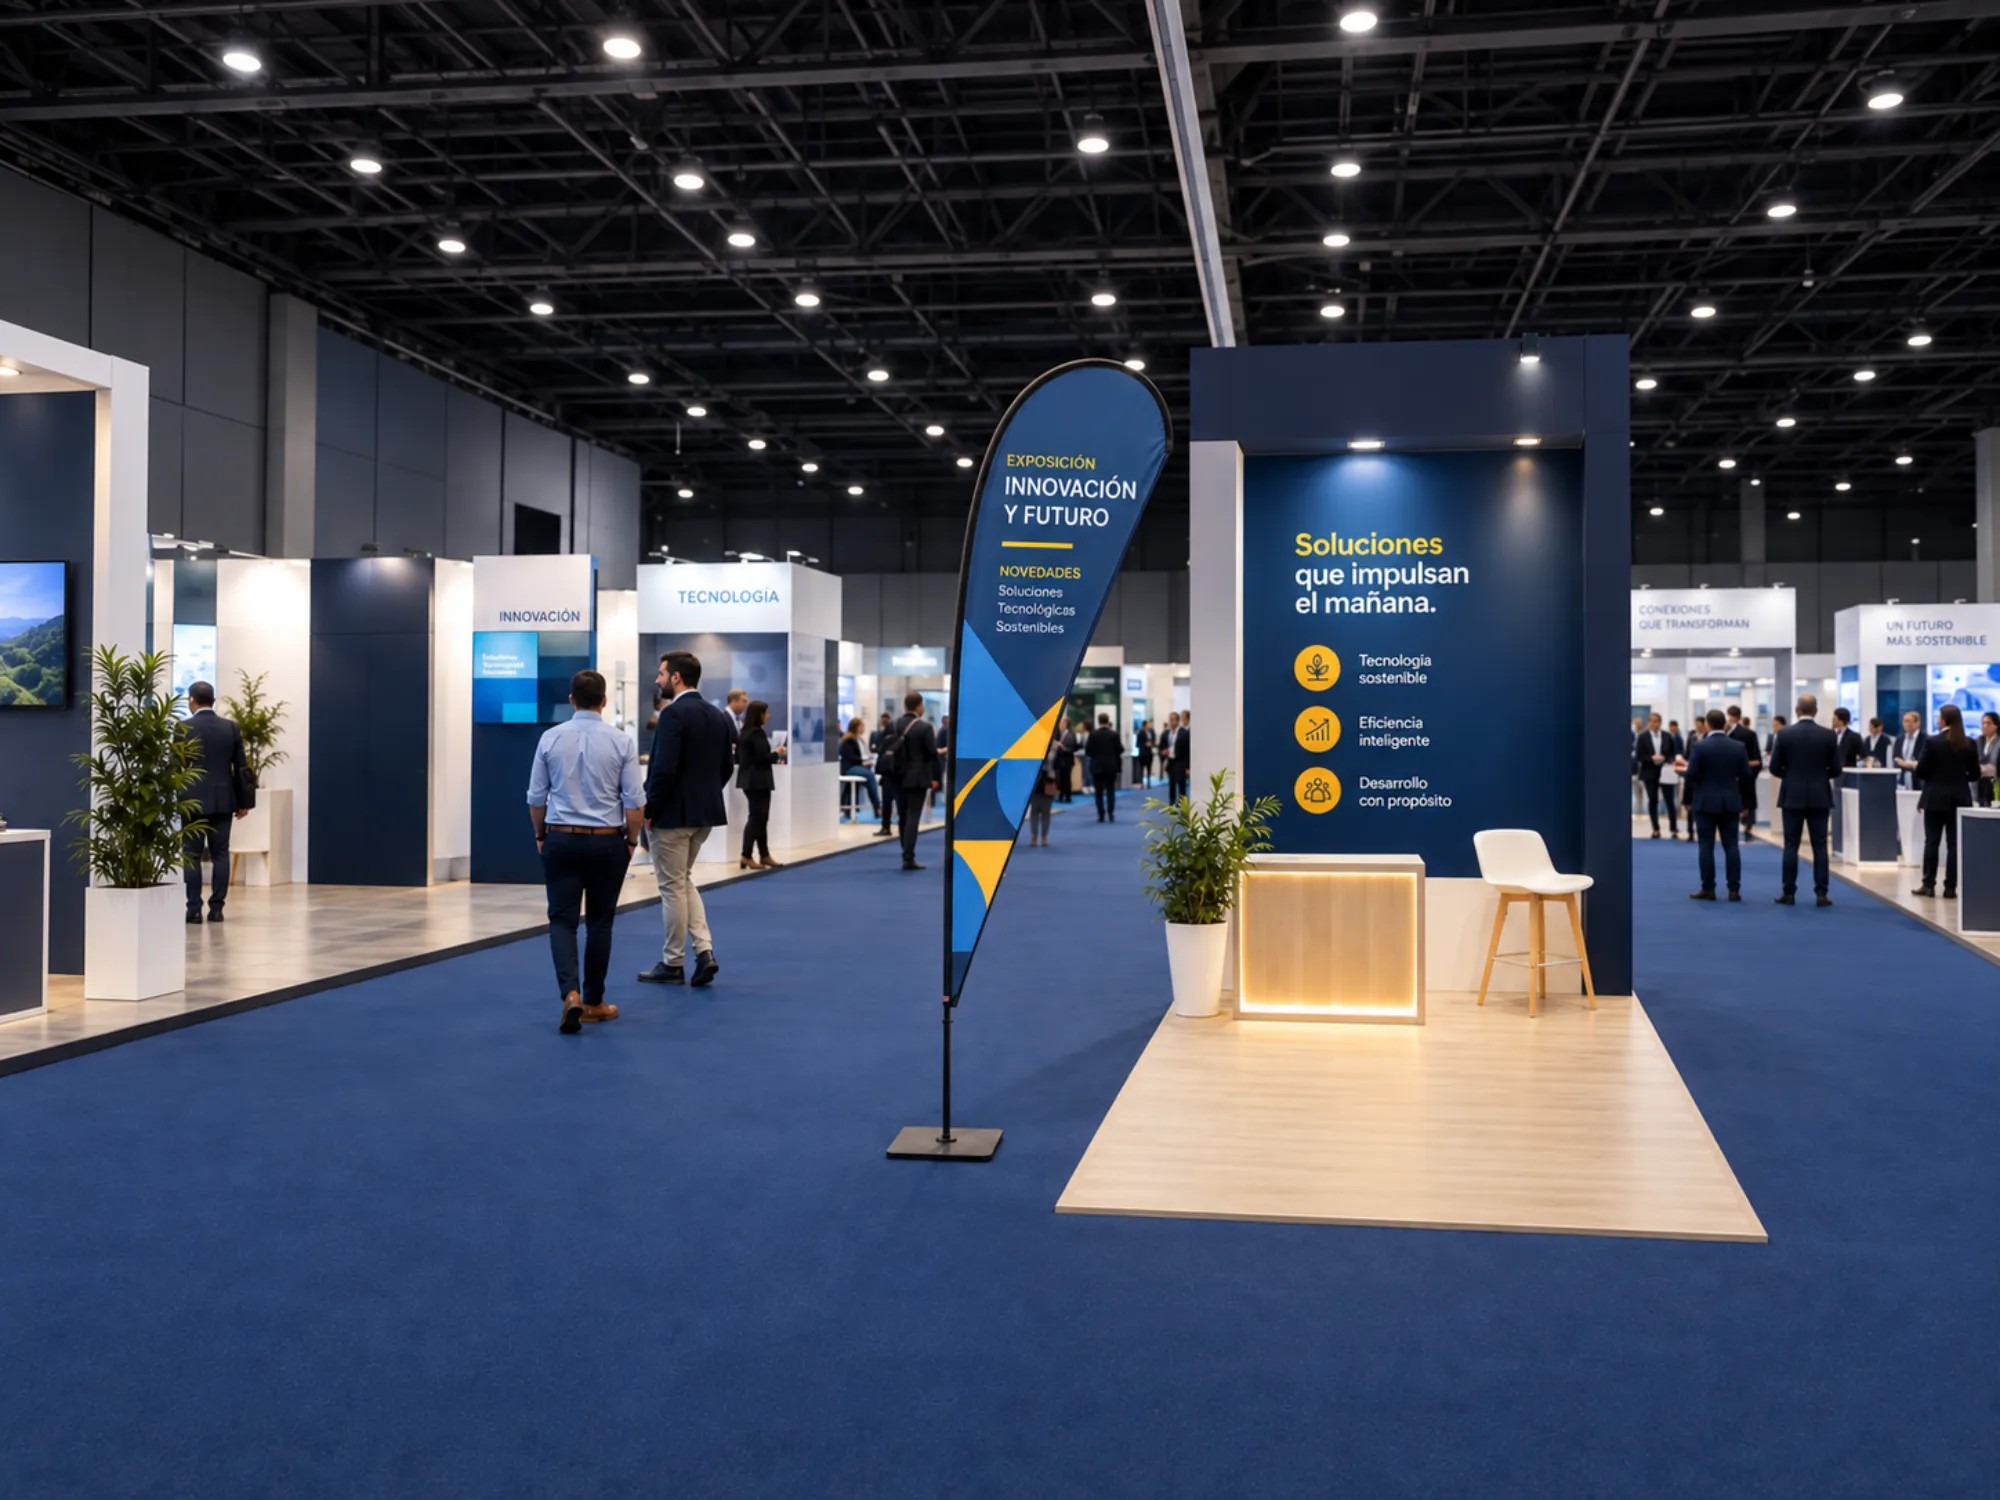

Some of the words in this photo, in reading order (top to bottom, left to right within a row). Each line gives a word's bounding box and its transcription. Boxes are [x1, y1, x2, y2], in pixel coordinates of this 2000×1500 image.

[1006, 453, 1096, 470] EXPOSICIÓN
[1004, 474, 1137, 500] INNOVACIÓN
[1003, 503, 1018, 524] Y
[1023, 505, 1110, 527] FUTURO
[1295, 531, 1444, 556] Soluciones
[999, 565, 1081, 580] NOVEDADES
[1295, 567, 1345, 591] que
[1351, 561, 1470, 591] impulsan
[998, 584, 1064, 598] Soluciones
[1295, 591, 1317, 614] el
[1324, 590, 1437, 614] mañana.
[499, 608, 581, 623] INNOVACIÓN
[995, 620, 1065, 634] Sostenibles
[1638, 620, 1662, 631] QUE
[1665, 618, 1750, 630] TRANSFORMAN
[1886, 621, 1904, 631] UN
[1907, 620, 1954, 631] FUTURO
[1915, 634, 1988, 647] SOSTENIBLE
[1358, 671, 1428, 685] sostenible
[1358, 715, 1424, 730] Eficiencia
[1358, 733, 1431, 750] inteligente
[1358, 776, 1429, 790] Desarrollo
[1358, 796, 1385, 808] con
[1387, 793, 1453, 810] propósito
